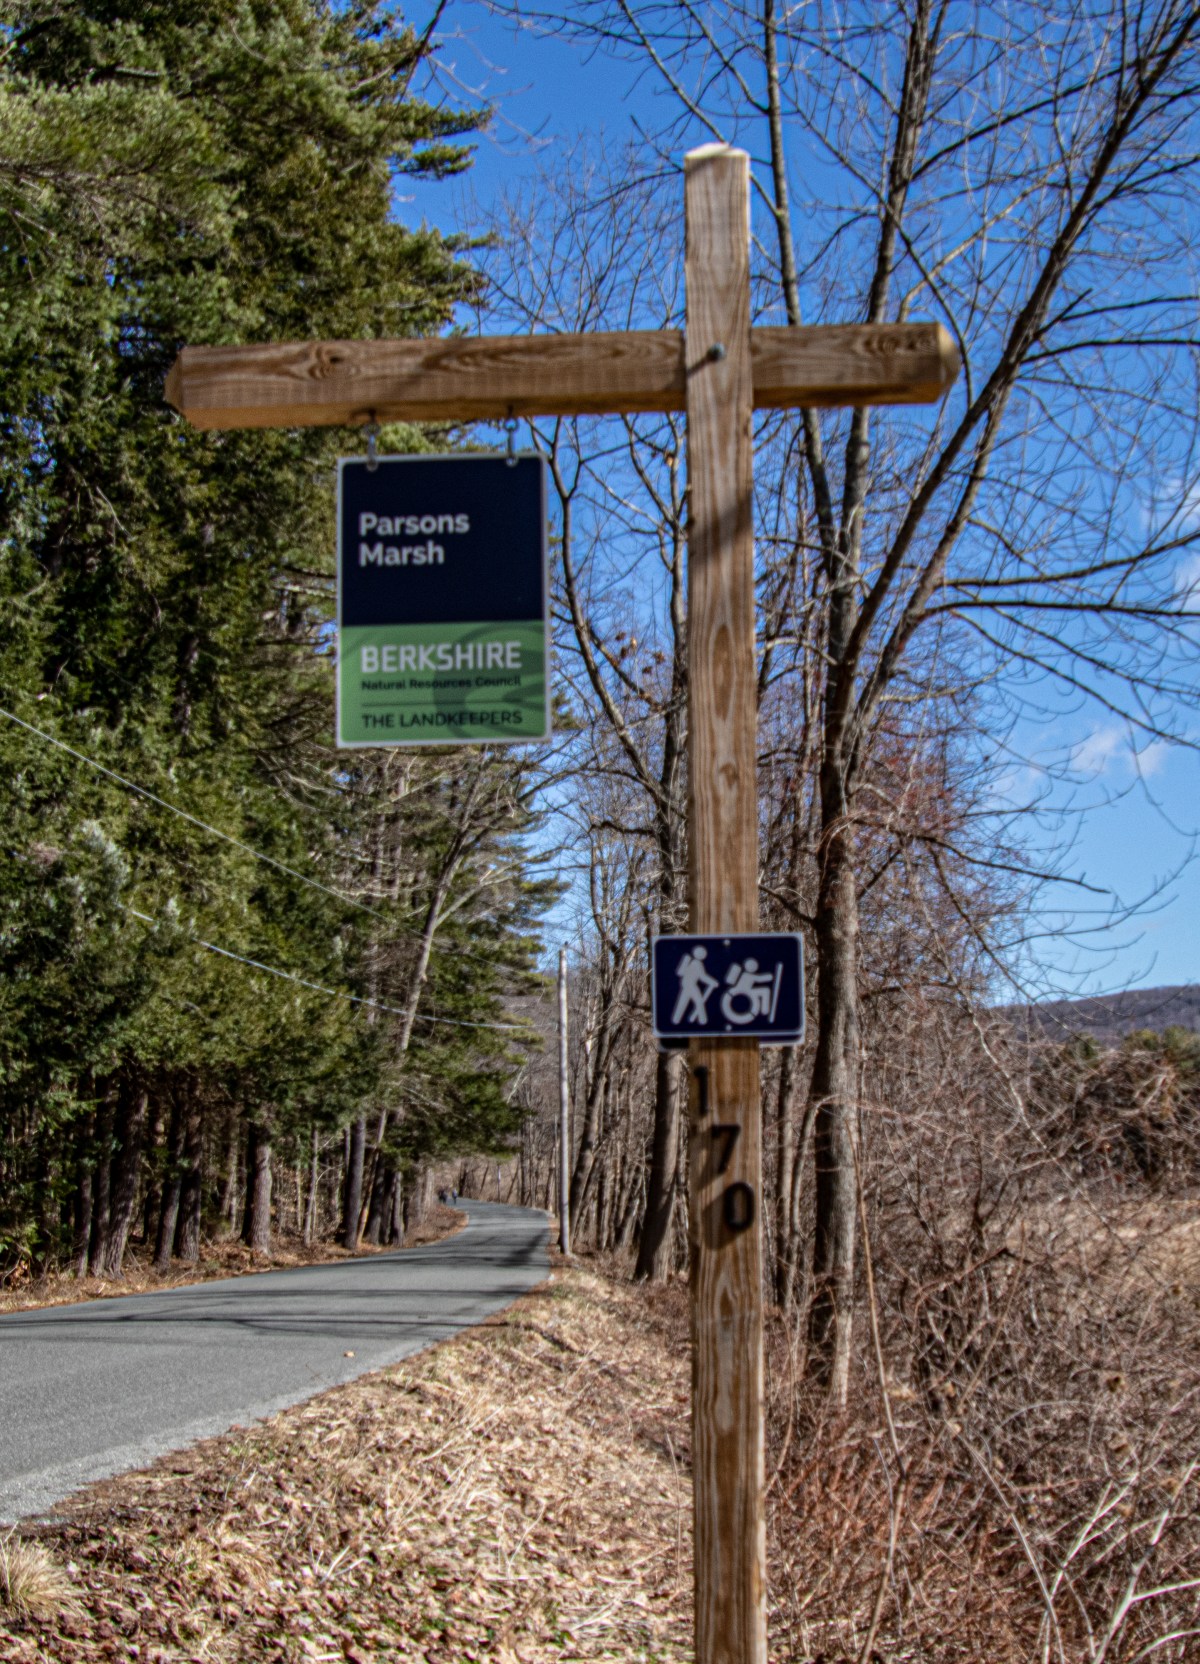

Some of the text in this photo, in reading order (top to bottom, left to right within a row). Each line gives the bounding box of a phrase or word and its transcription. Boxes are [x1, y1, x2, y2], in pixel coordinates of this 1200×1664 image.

[359, 512, 470, 536] Parsons
[359, 539, 445, 567] Marsh
[361, 641, 522, 673] BERKSHIRE
[361, 675, 521, 691] Natural Resources Council
[362, 710, 523, 728] THE LANDKEEPERS
